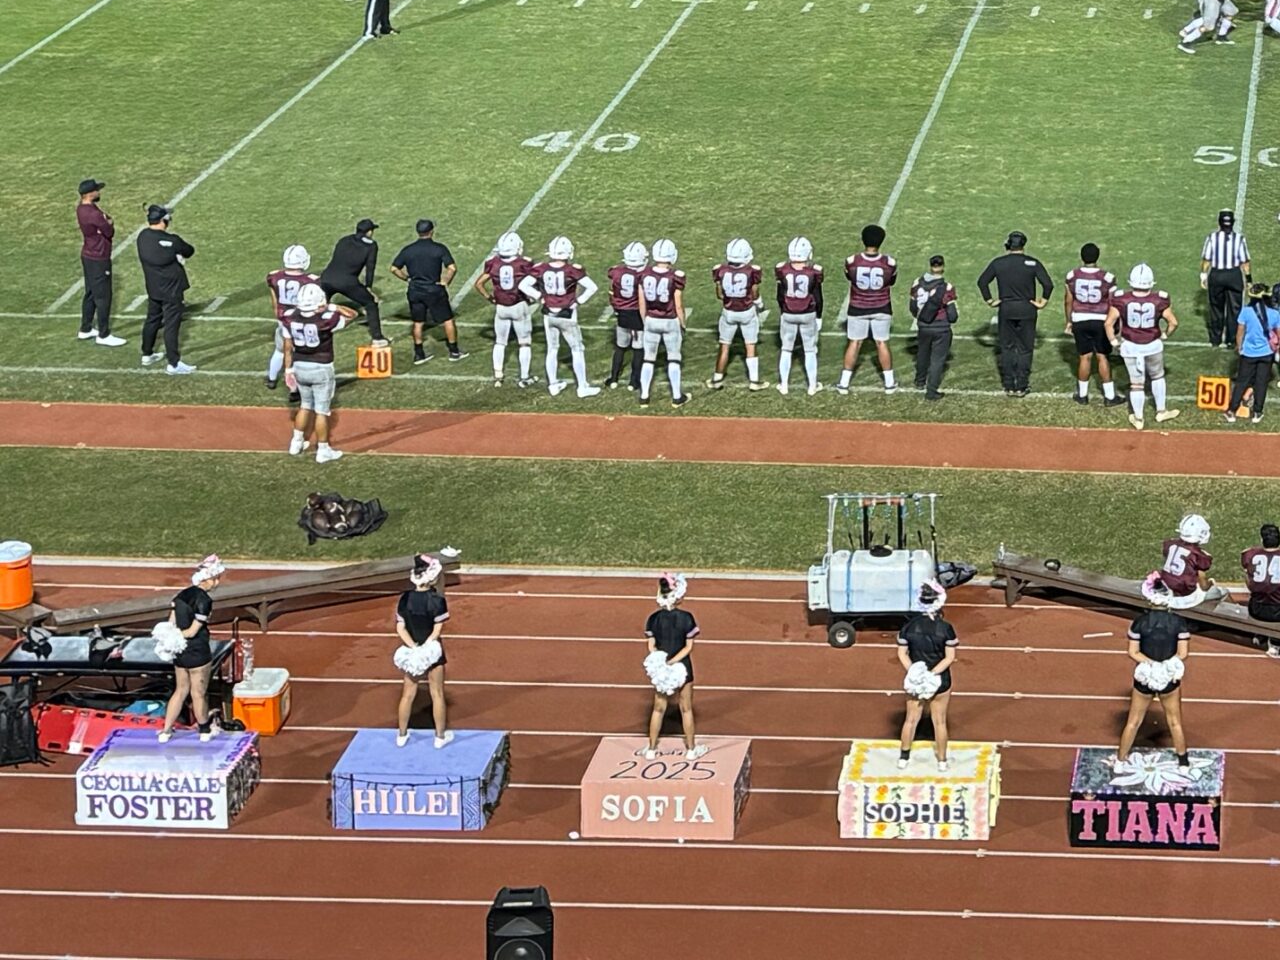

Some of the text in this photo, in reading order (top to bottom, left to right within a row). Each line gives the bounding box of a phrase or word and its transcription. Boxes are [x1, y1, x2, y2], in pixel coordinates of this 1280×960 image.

[785, 273, 809, 299] 13
[856, 266, 884, 291] 56
[1074, 278, 1102, 304] 55
[1126, 302, 1155, 328] 62
[361, 350, 388, 374] 40
[1201, 381, 1227, 407] 50
[1163, 543, 1191, 577] 15
[609, 760, 717, 781] 2025
[165, 776, 221, 794] GALE
[86, 793, 217, 821] FOSTER
[601, 794, 715, 824] SOFIA
[864, 802, 965, 825] SOPHIE
[1072, 800, 1220, 844] TIANA
